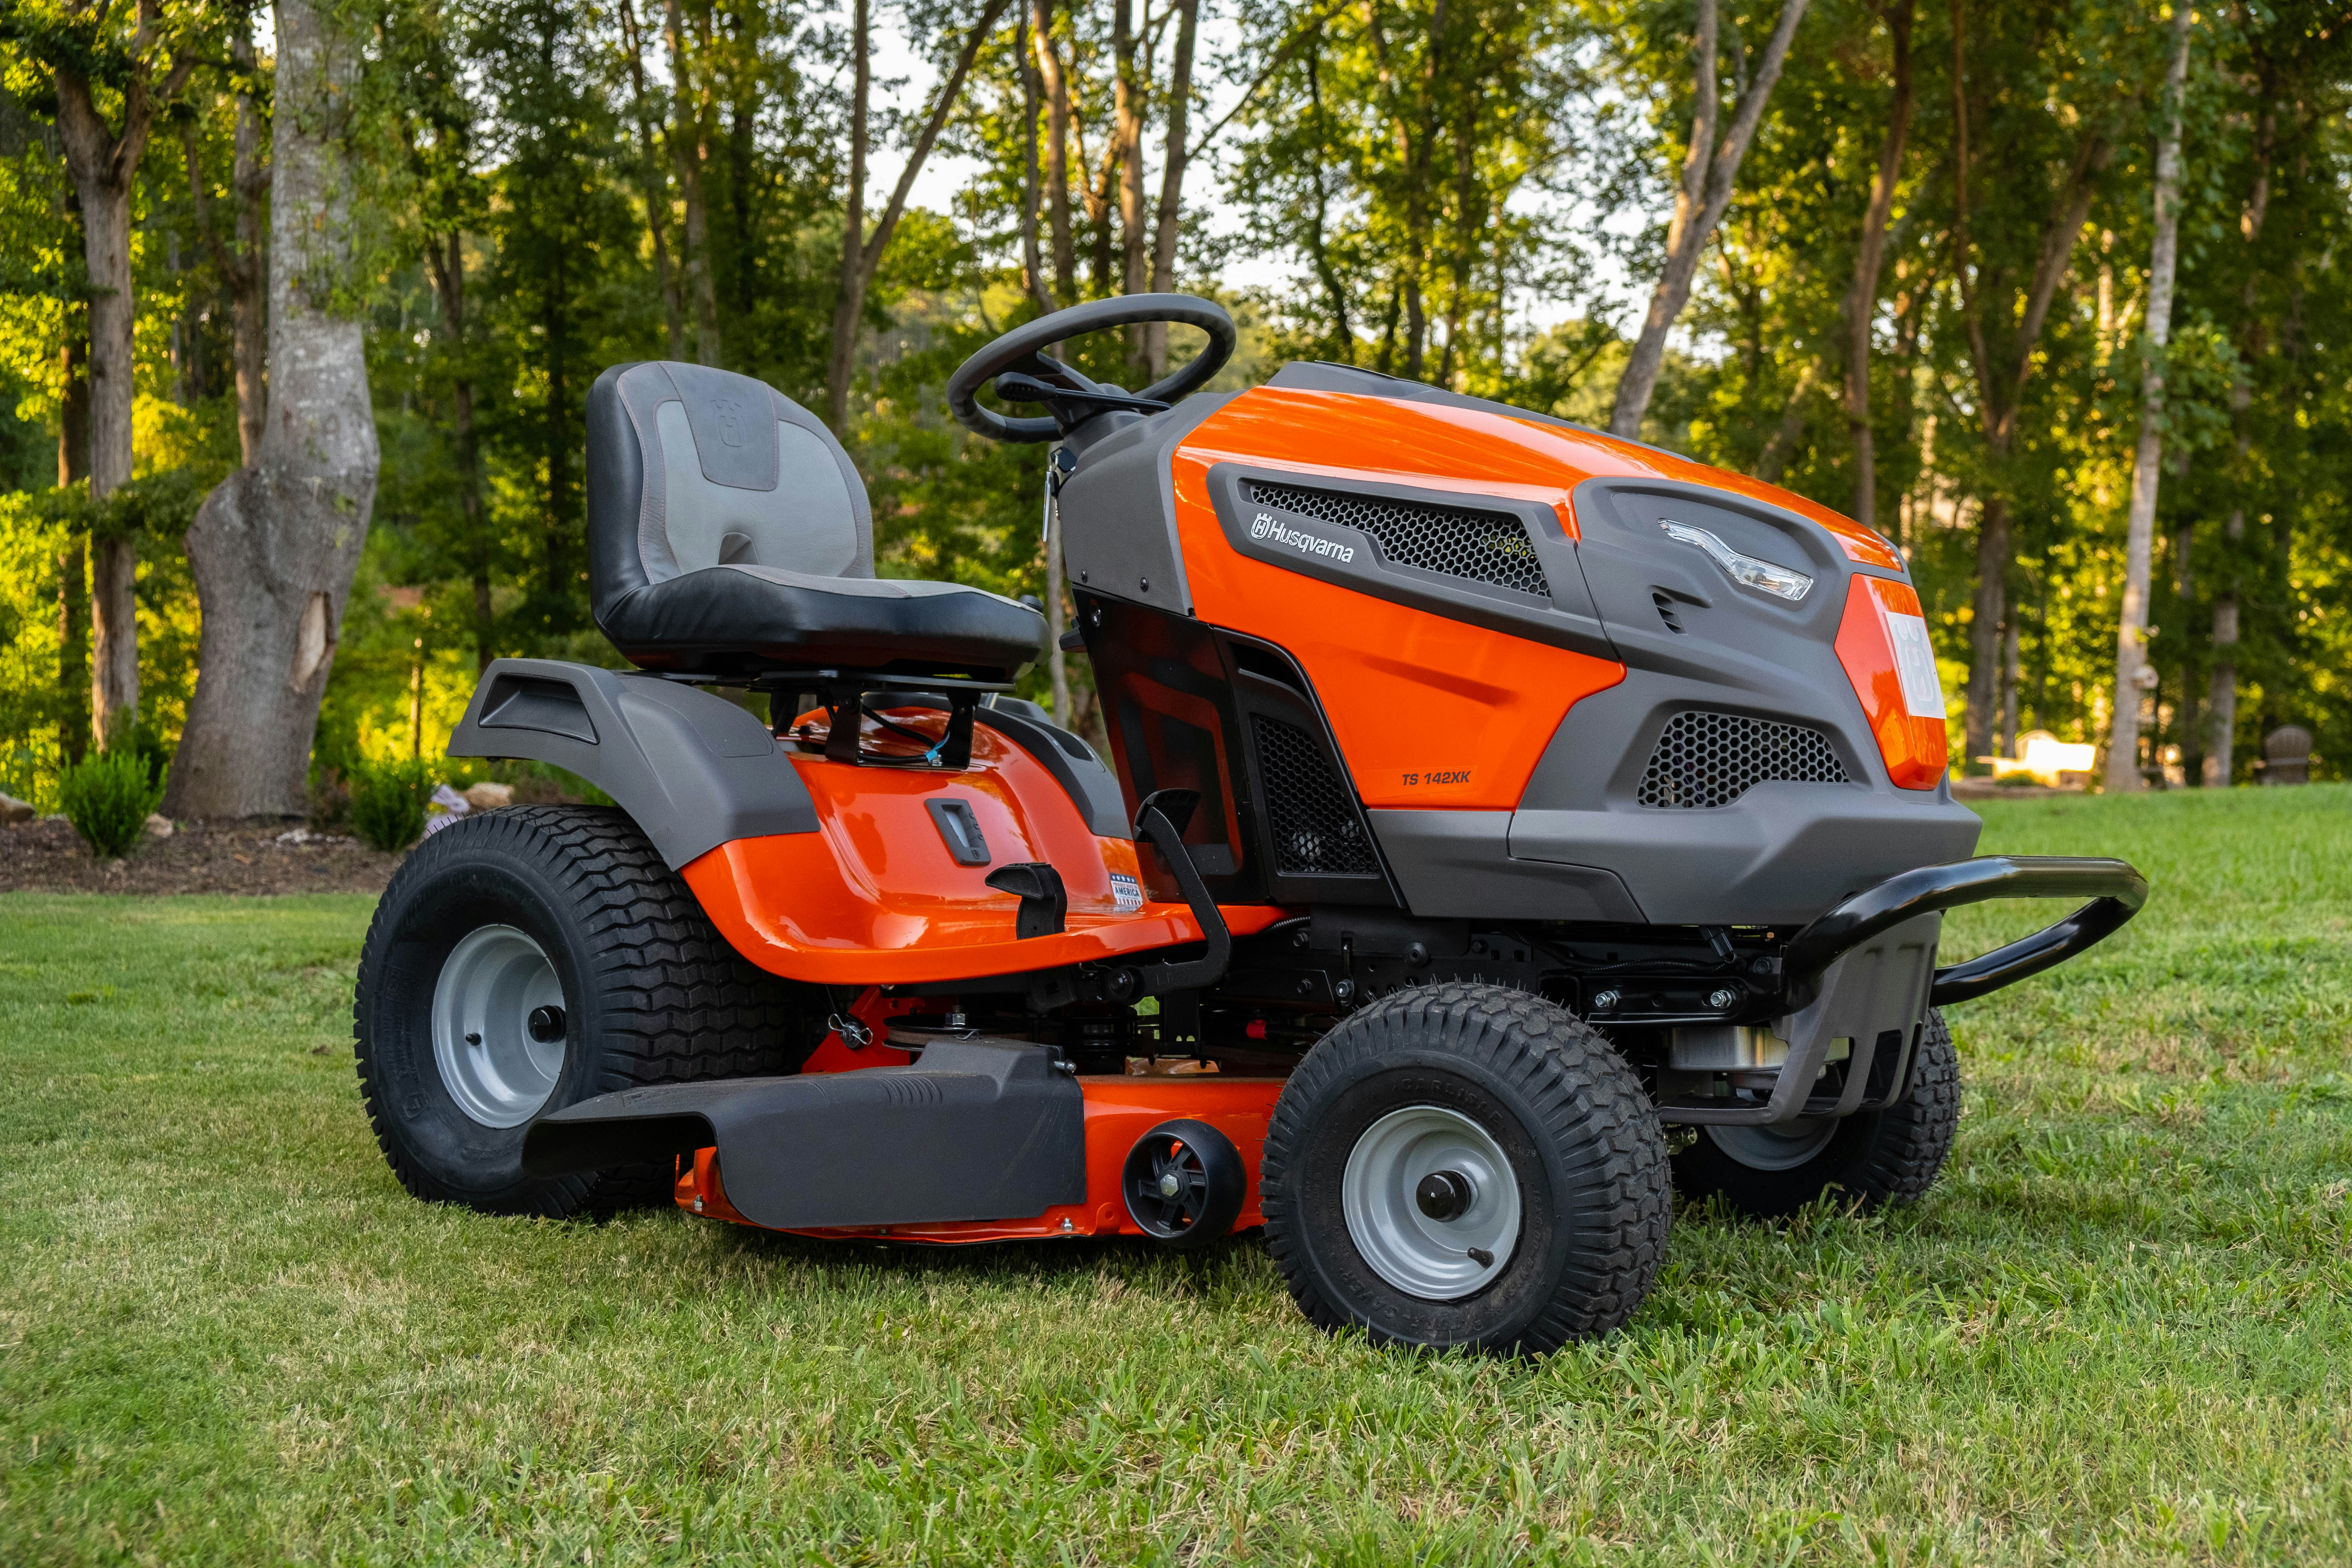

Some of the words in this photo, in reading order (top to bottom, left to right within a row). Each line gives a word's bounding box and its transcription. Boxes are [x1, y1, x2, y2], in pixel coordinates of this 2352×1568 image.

[1267, 520, 1354, 564] Husqvarna
[1403, 773, 1418, 786] TS
[1424, 771, 1472, 784] 142XK
[1115, 887, 1140, 897] AMERICA
[1401, 1078, 1503, 1124] CARLISLE
